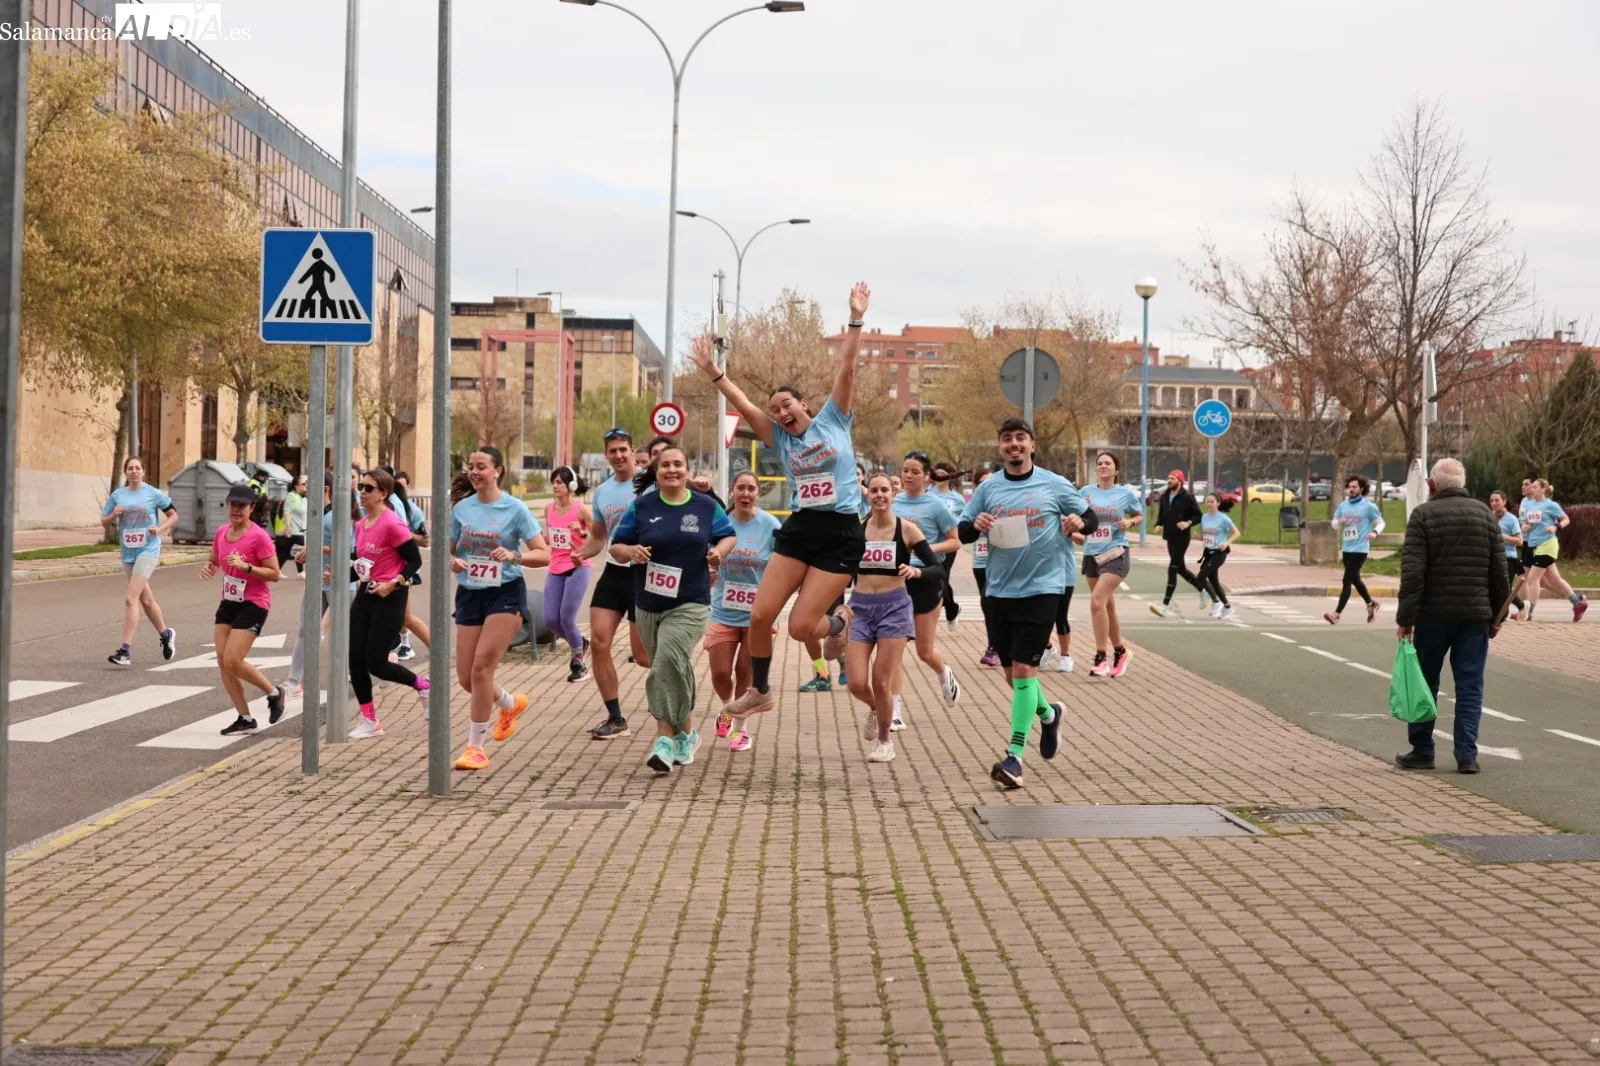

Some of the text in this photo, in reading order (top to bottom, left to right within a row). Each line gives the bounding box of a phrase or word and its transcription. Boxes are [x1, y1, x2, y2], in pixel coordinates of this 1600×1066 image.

[657, 414, 677, 427] 30
[800, 481, 834, 499] 262
[125, 533, 145, 543] 267
[553, 533, 567, 544] 65
[863, 548, 894, 562] 206
[469, 563, 498, 579] 271
[648, 571, 677, 589] 150
[224, 582, 238, 596] 66
[725, 588, 757, 604] 265
